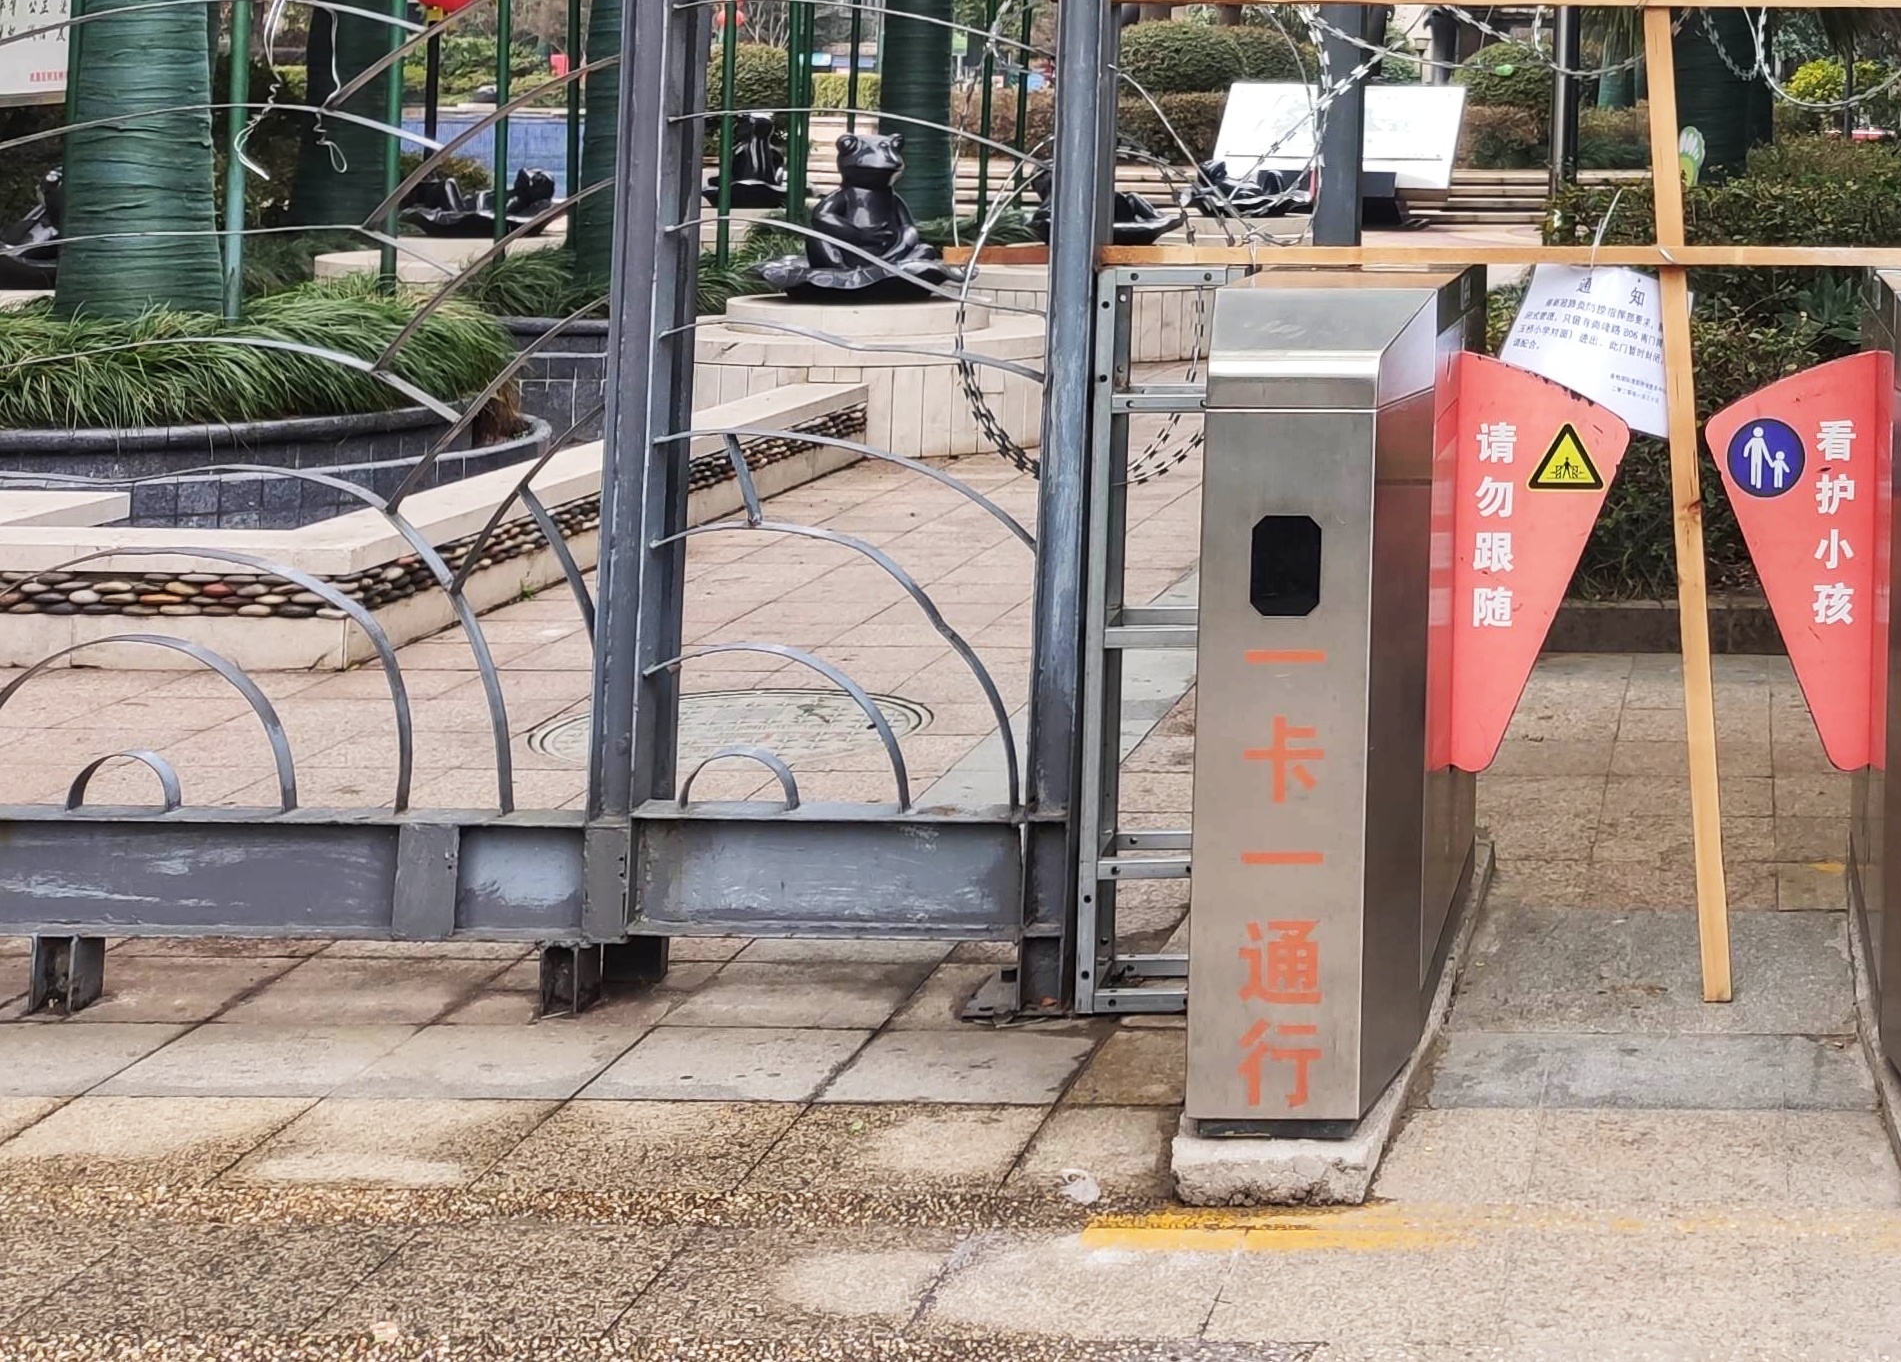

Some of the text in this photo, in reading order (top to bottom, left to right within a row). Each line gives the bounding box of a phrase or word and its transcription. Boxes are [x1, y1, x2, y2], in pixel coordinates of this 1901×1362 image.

[1471, 421, 1518, 629] 请勿跟随
[1811, 418, 1857, 626] 看护小孩
[1236, 647, 1327, 1111] 一卡一通行
